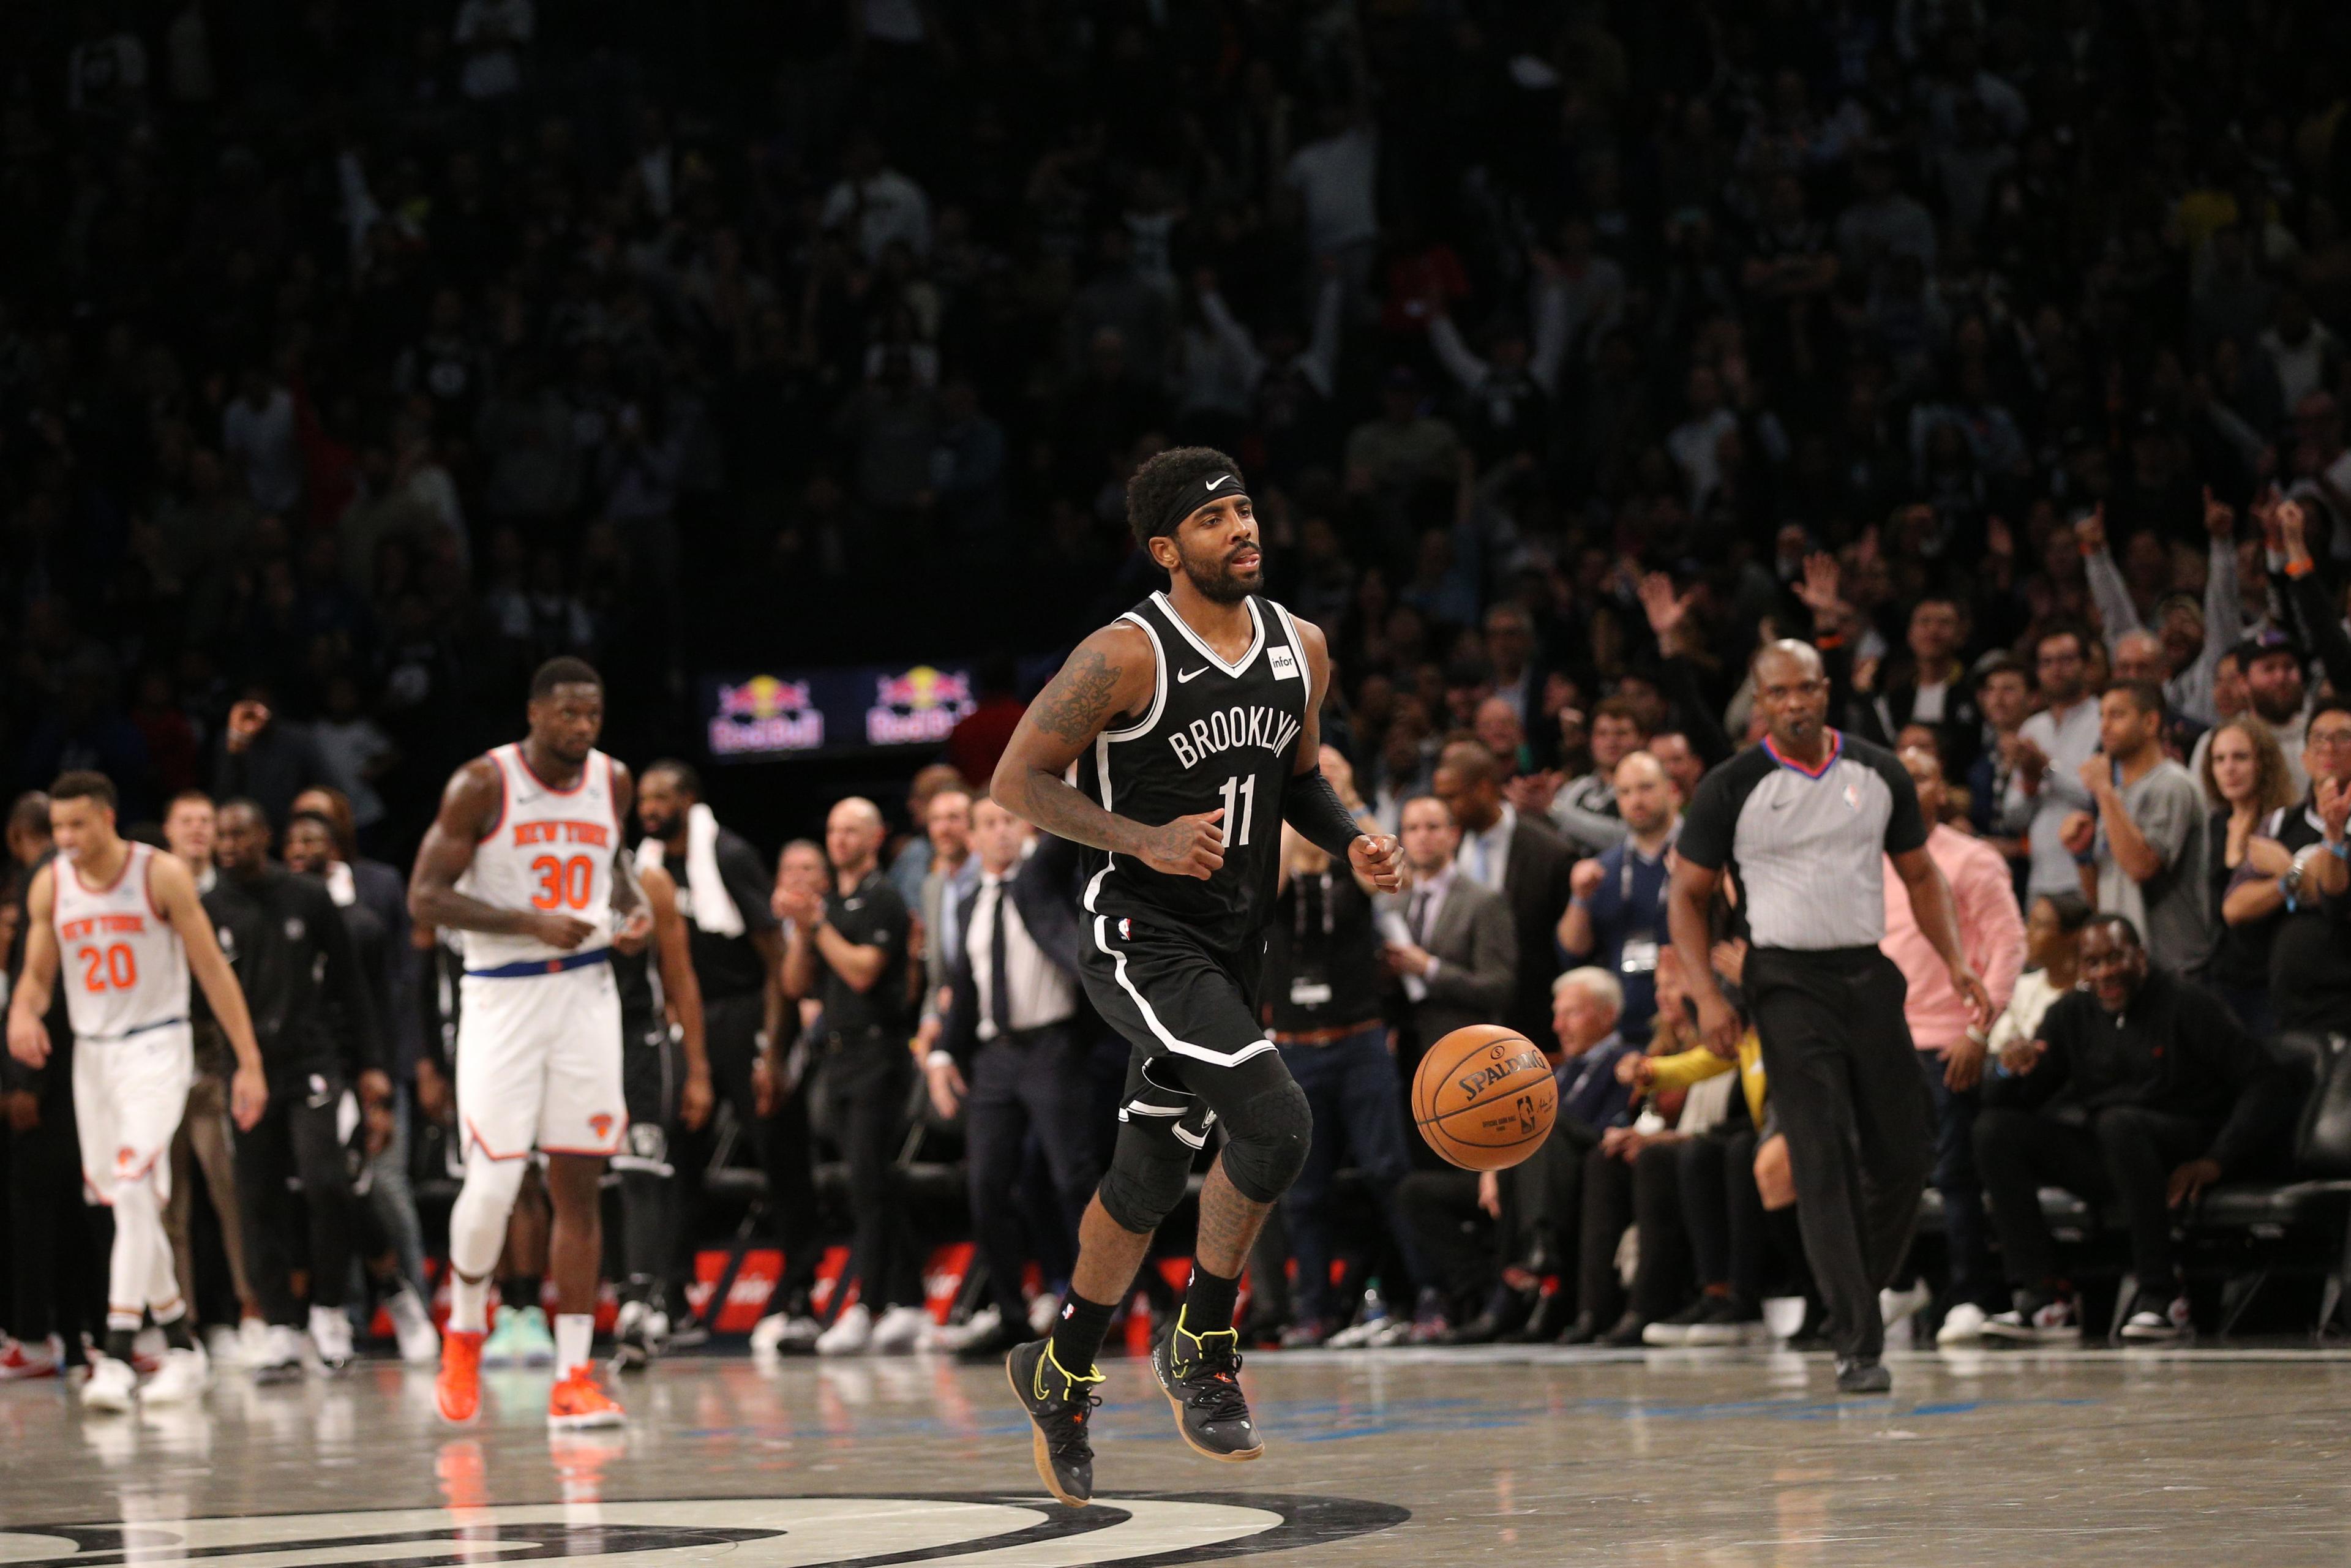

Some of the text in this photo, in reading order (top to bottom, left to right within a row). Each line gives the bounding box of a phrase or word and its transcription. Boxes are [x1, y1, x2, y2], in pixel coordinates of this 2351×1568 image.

[1272, 655, 1293, 669] infor
[1168, 706, 1300, 769] BROOKLYN
[514, 821, 557, 847] NEW
[1219, 774, 1255, 848] 11
[531, 855, 593, 909] 30
[78, 943, 137, 991] 20
[1459, 1049, 1547, 1101] SPALDING
